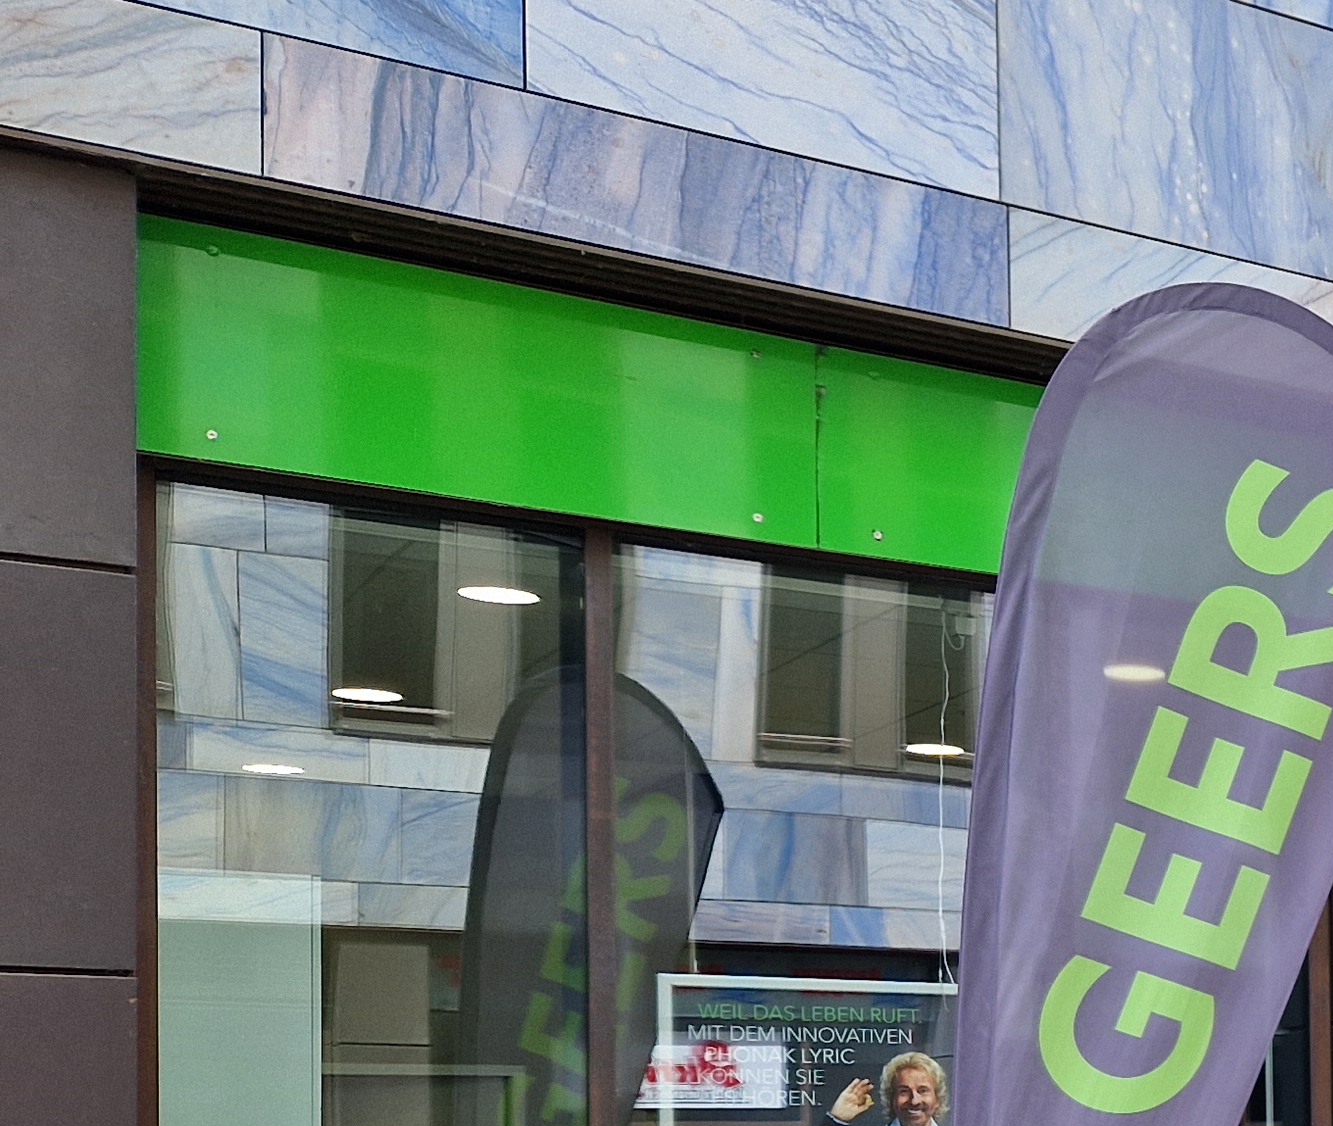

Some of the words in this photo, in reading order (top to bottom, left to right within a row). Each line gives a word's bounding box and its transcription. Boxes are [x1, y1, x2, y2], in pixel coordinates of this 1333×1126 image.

[697, 1003, 749, 1020] WEIL
[753, 1005, 796, 1021] DAS
[801, 1006, 864, 1023] LEBEN
[870, 1008, 922, 1024] RUFT.
[688, 1024, 726, 1042] MIT
[730, 1026, 776, 1042] DEM
[782, 1026, 914, 1045] INNOVATIVEN
[705, 1046, 797, 1064] PHONAK
[801, 1047, 856, 1065] LYRIC
[795, 1068, 826, 1086] SIE
